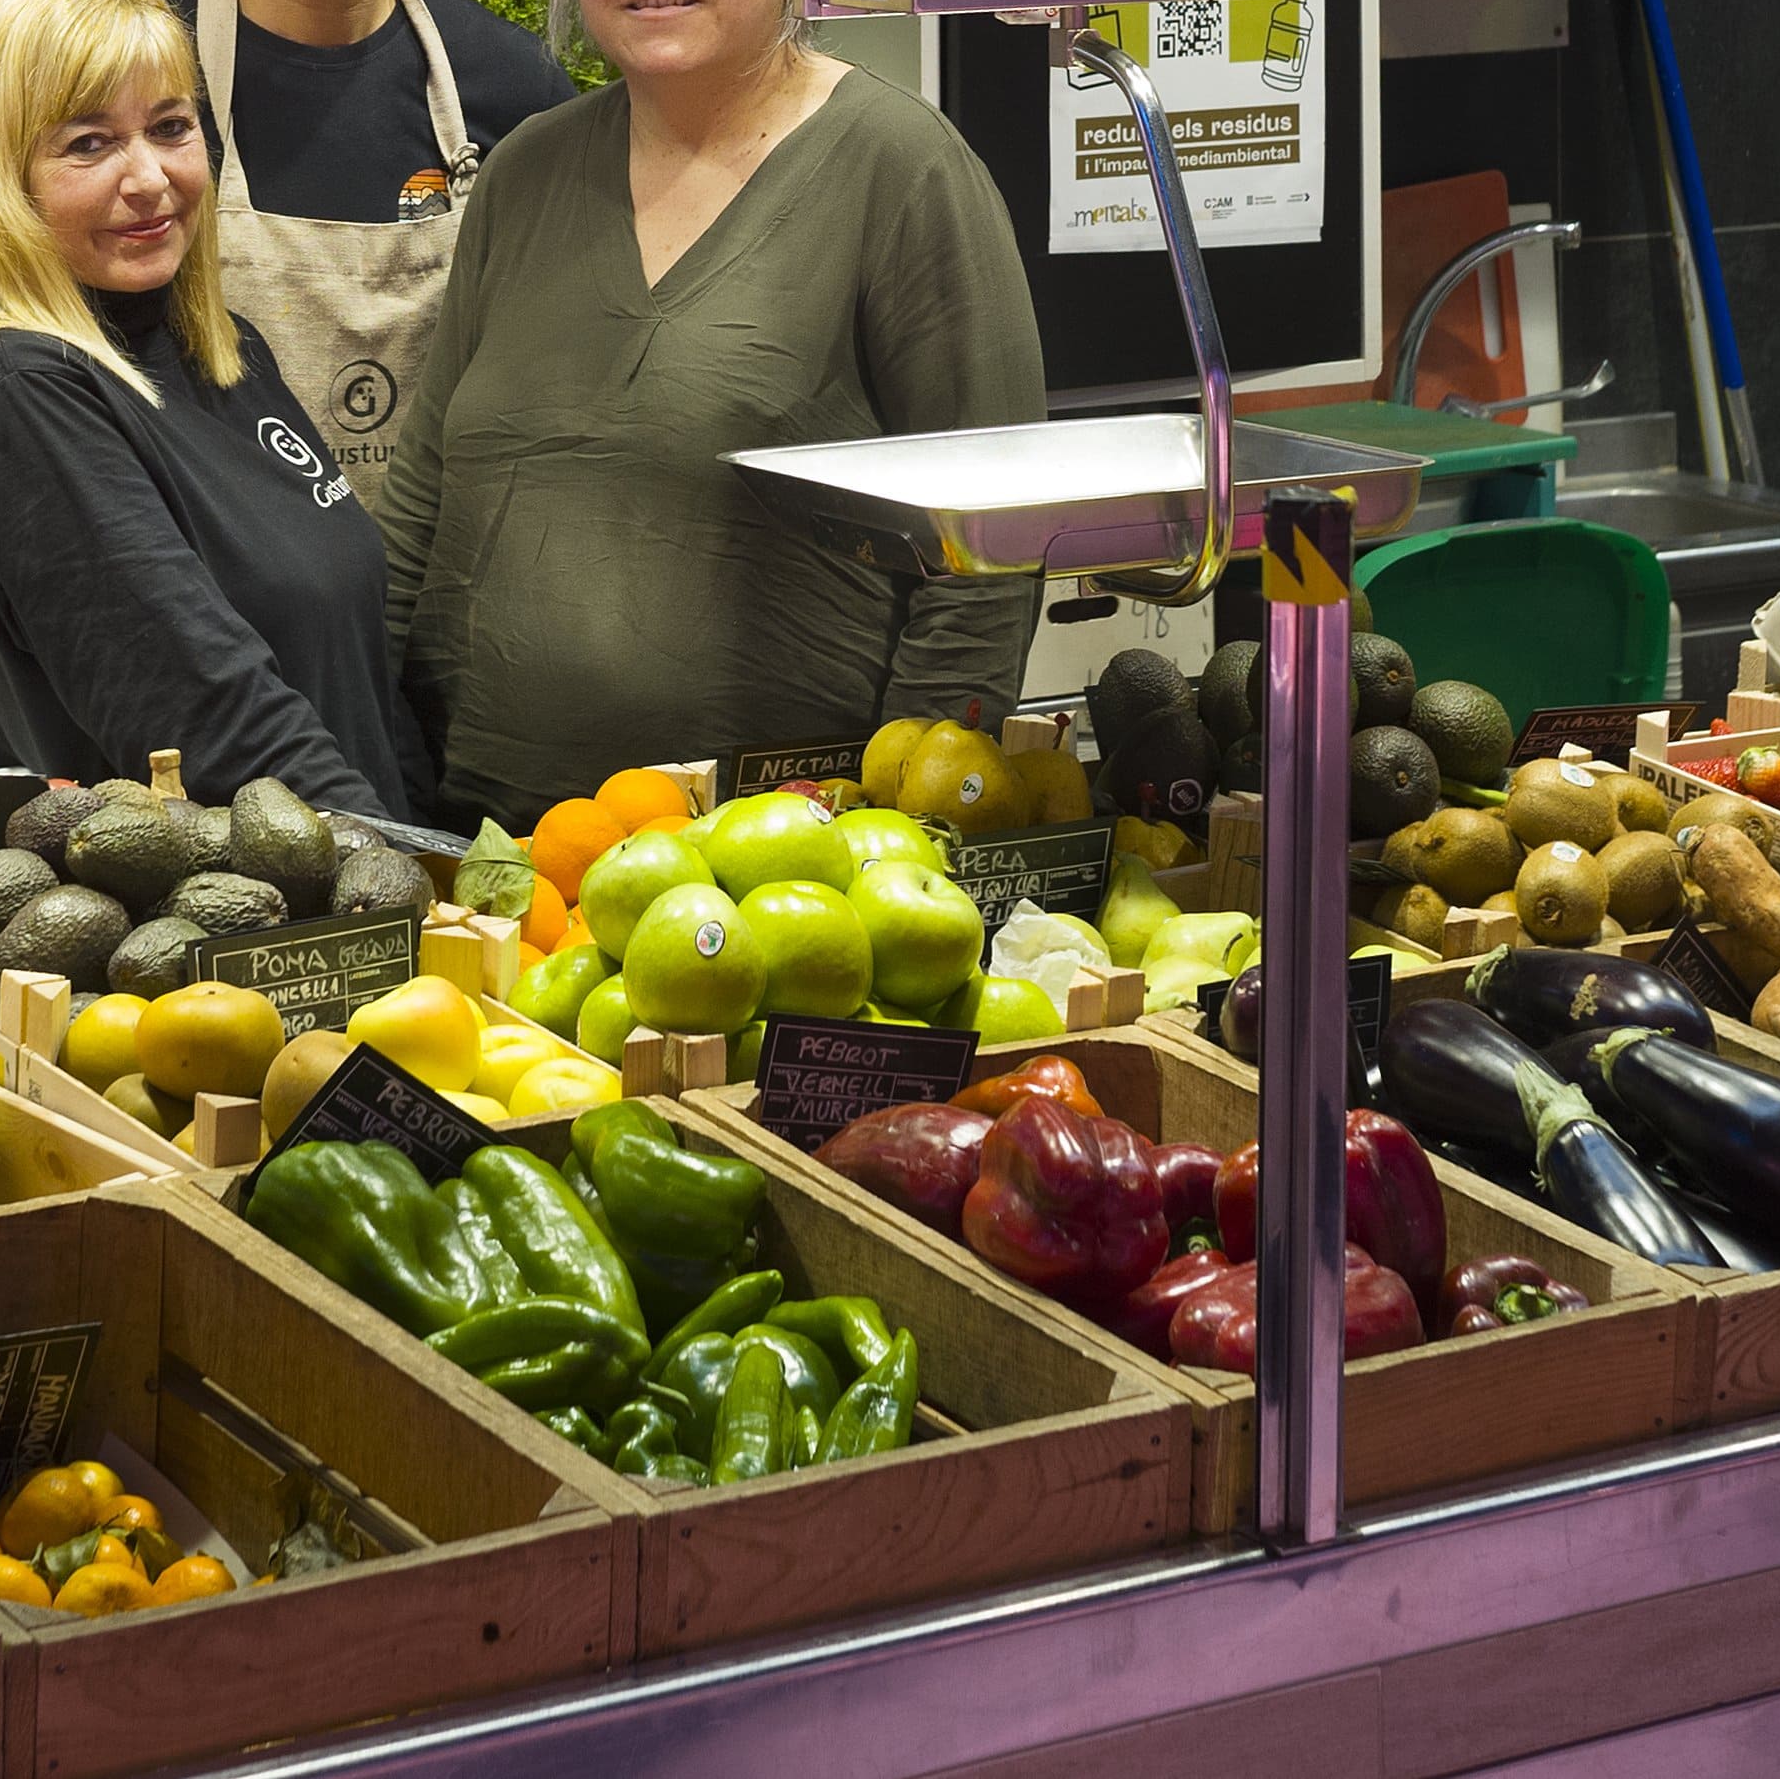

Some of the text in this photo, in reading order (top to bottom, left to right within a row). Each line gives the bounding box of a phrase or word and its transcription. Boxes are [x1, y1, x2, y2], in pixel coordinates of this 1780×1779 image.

[1173, 112, 1292, 139] els residus
[1094, 154, 1149, 174] l'impac
[955, 846, 1027, 877] PERA
[249, 948, 328, 980] POMA
[267, 977, 339, 1006] ONCELLA
[282, 1012, 316, 1037] AGO
[799, 1036, 900, 1068] PEBROT
[786, 1071, 885, 1097] VERMELL
[376, 1078, 471, 1153] PEBROT
